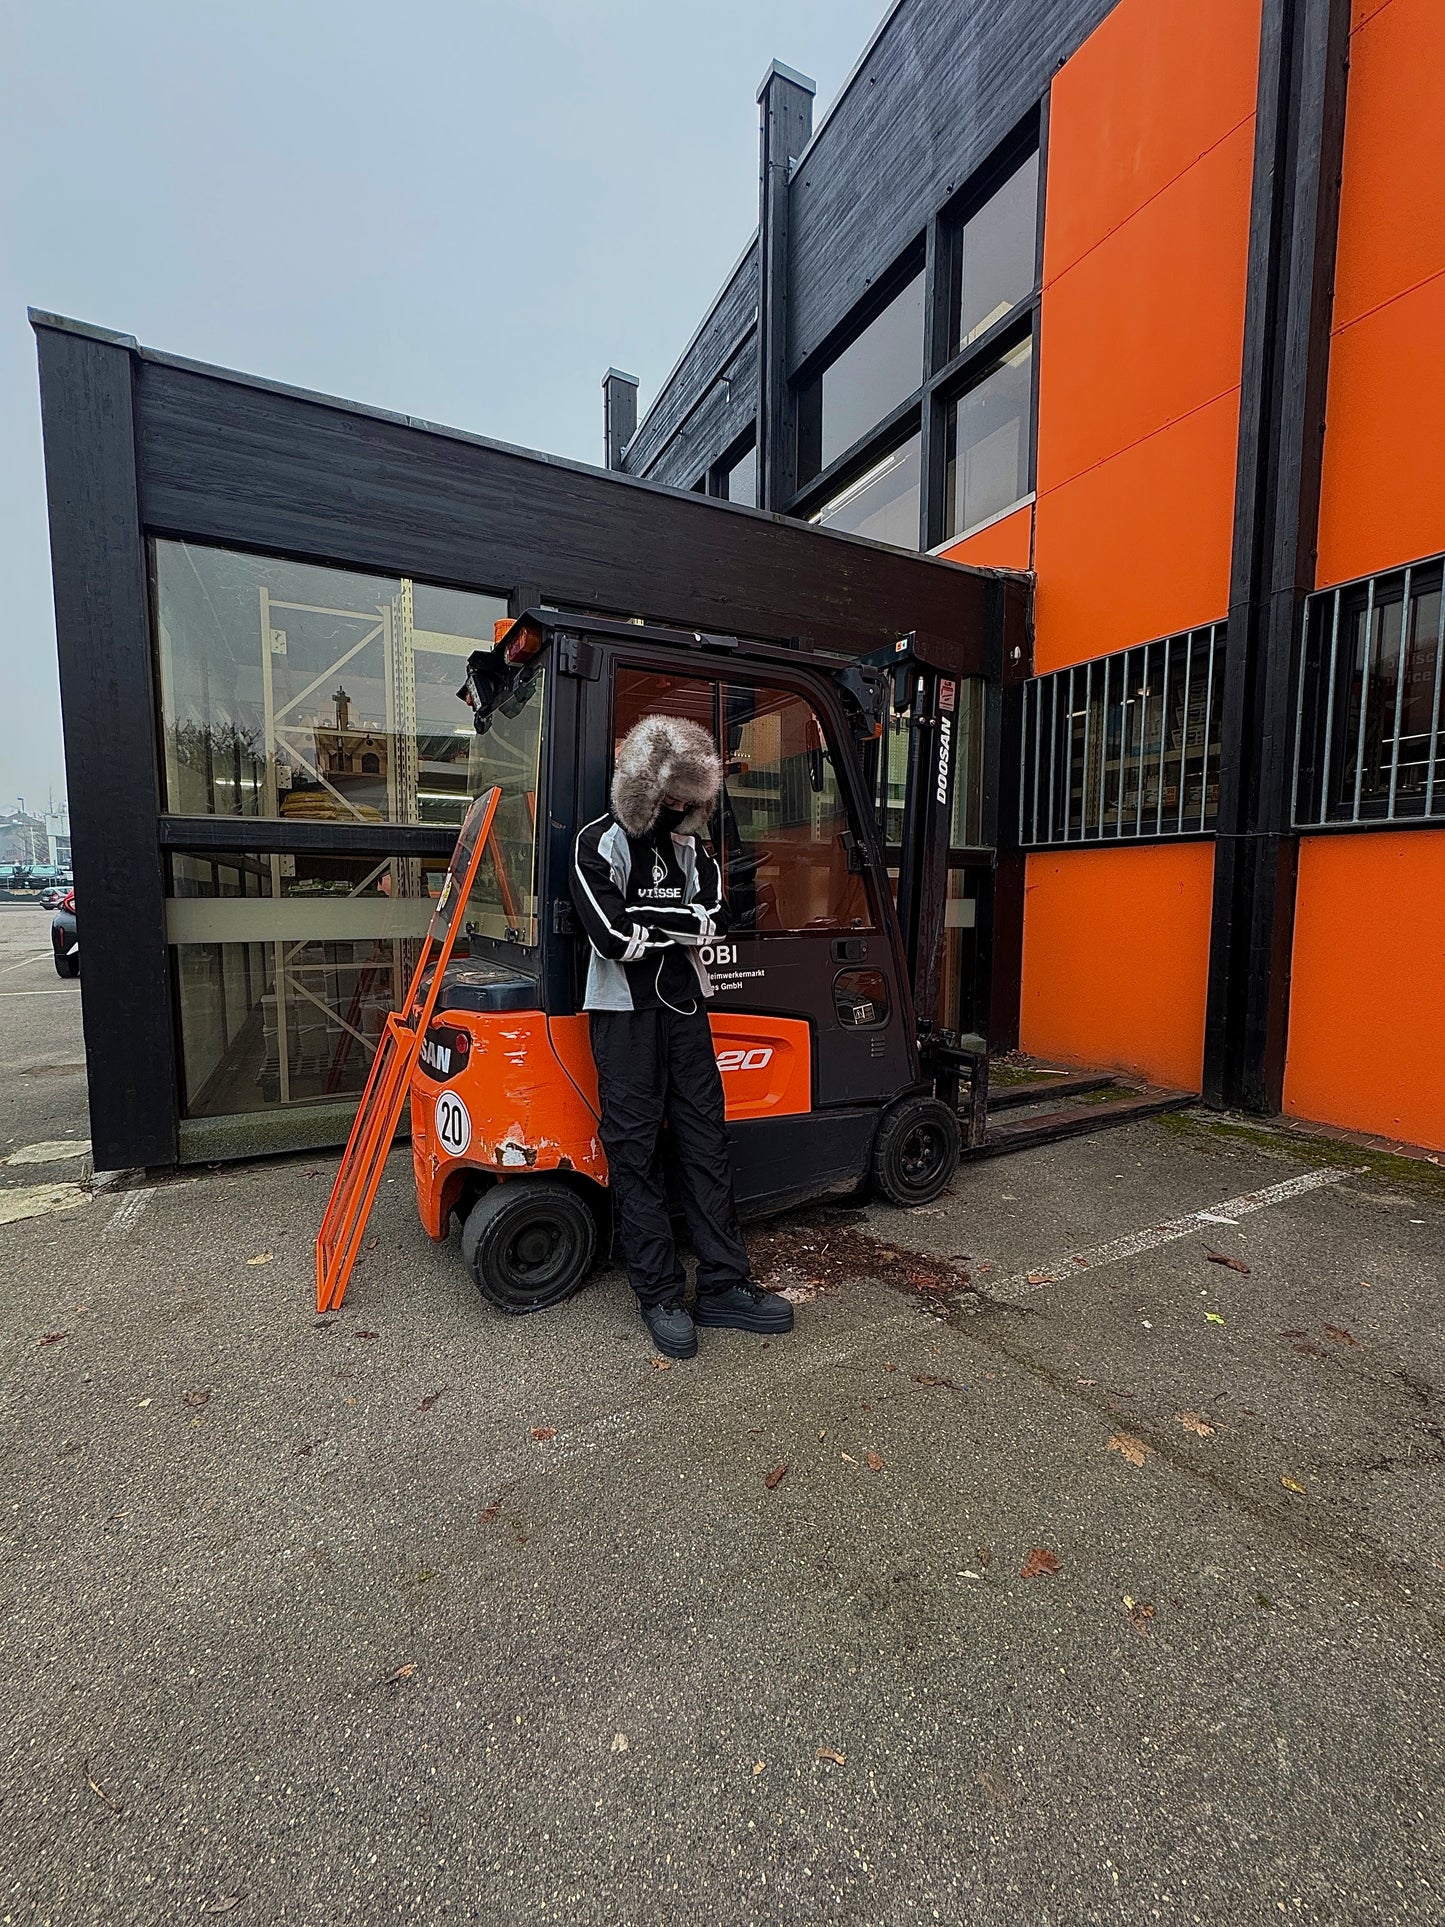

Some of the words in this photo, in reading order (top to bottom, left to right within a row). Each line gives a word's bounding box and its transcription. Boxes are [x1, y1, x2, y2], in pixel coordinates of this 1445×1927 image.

[936, 716, 952, 805] DOOSAN
[698, 944, 738, 966] OBI
[720, 981, 743, 991] GmbH
[715, 1048, 773, 1072] 20
[441, 1101, 462, 1146] 20
